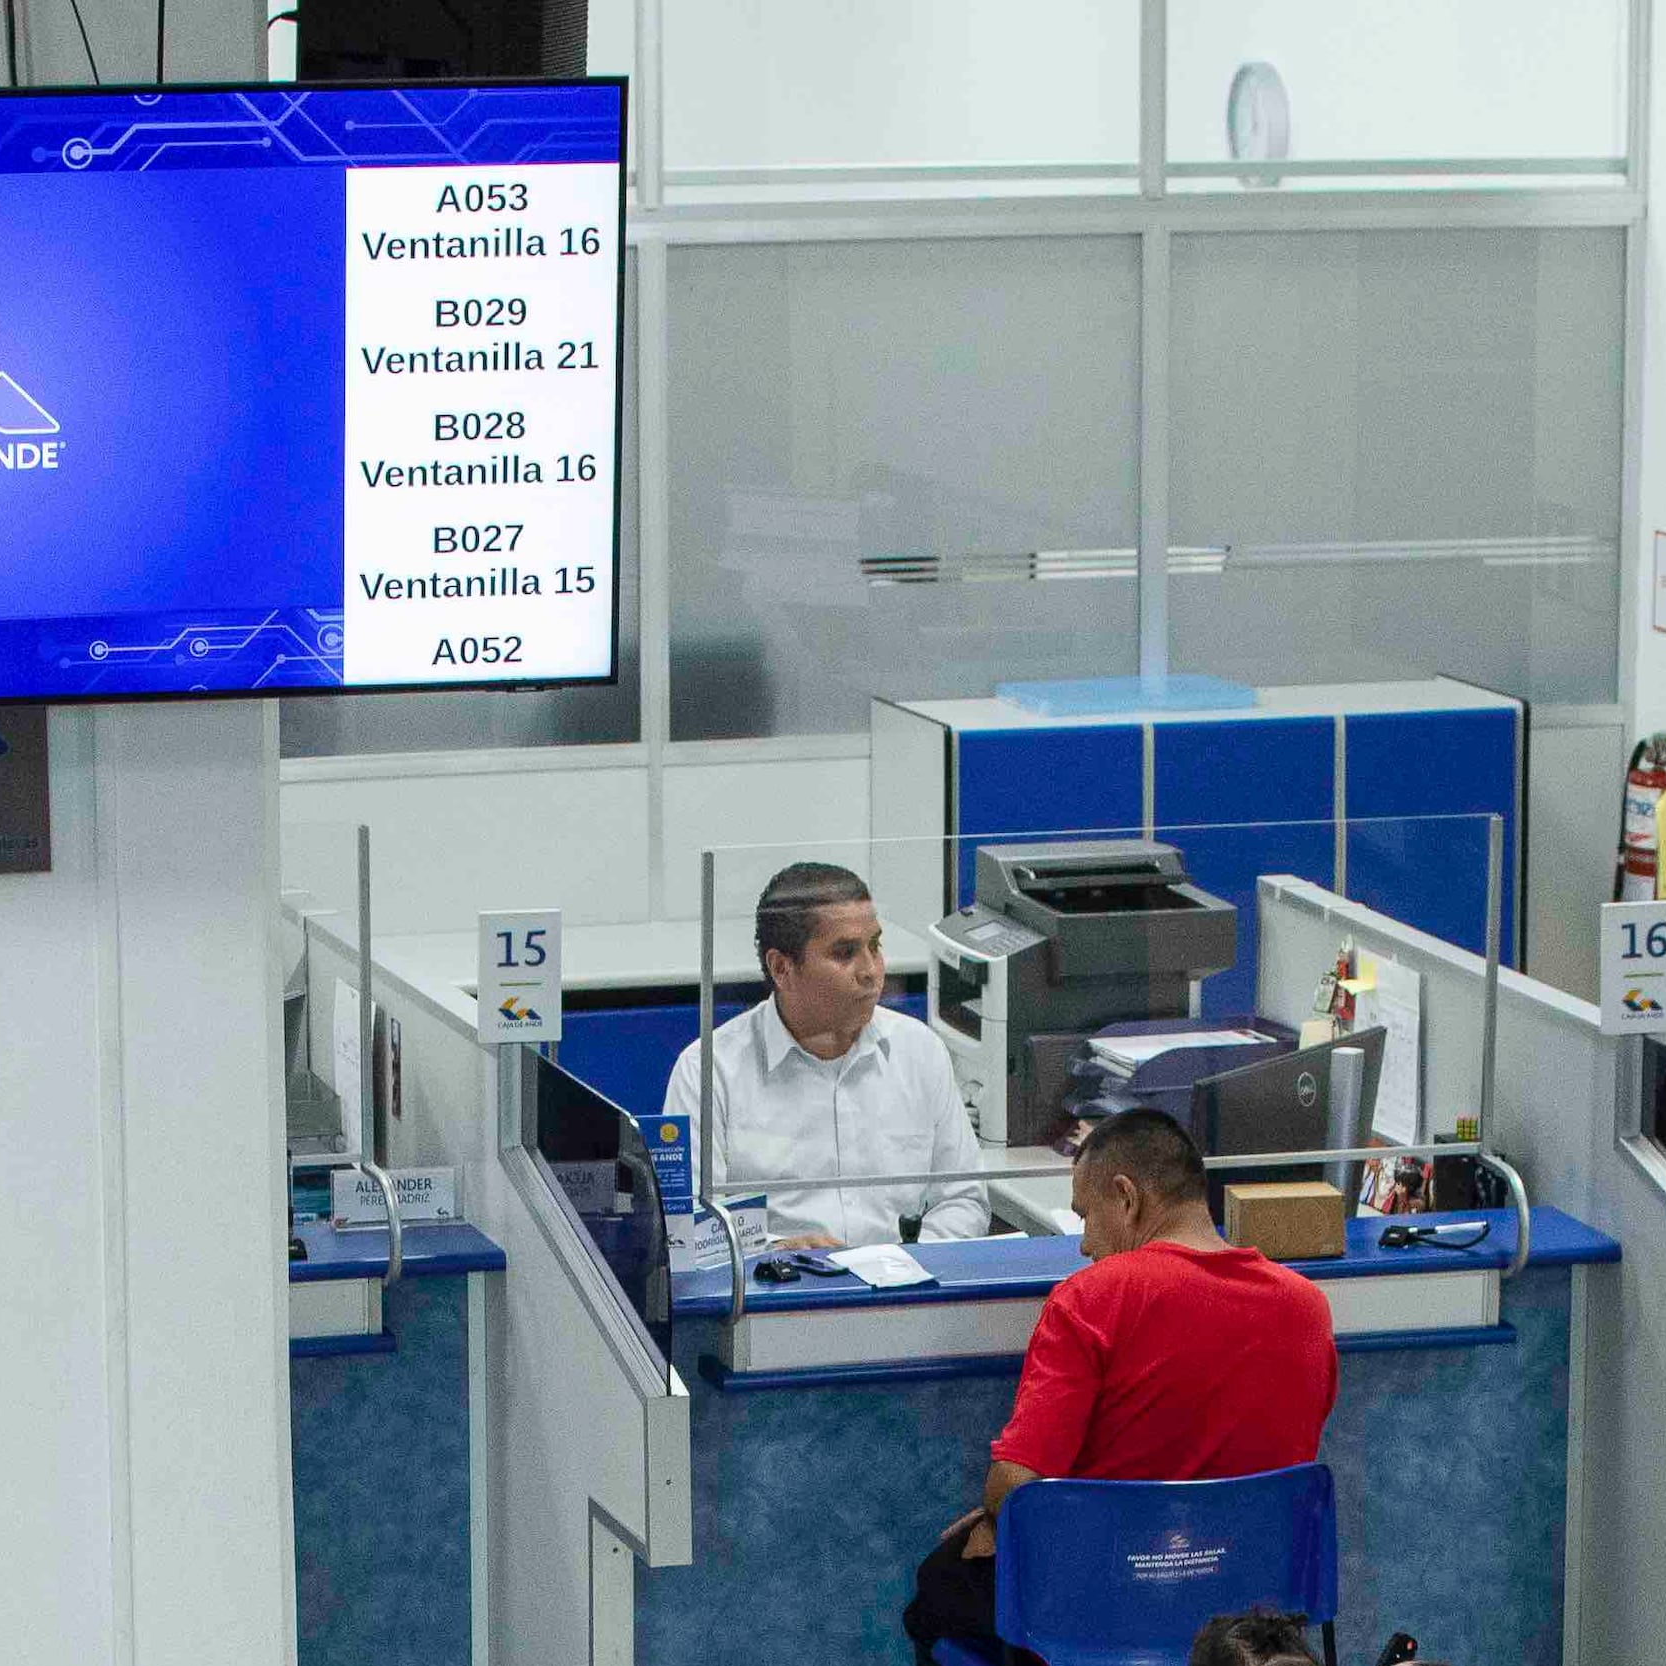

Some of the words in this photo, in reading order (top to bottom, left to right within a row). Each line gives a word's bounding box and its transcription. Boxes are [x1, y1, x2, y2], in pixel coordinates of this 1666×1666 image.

[436, 183, 528, 213] A053
[362, 227, 547, 260] Ventanilla
[560, 227, 600, 256] 16
[436, 298, 527, 328] B029
[361, 341, 545, 374] Ventanilla
[557, 341, 599, 369] 21
[435, 411, 525, 441] B028
[360, 455, 543, 488] Ventanilla
[556, 454, 596, 482] 16
[434, 524, 524, 554] B027
[359, 567, 542, 600] Ventanilla
[555, 566, 595, 594] 15
[431, 636, 522, 665] A052
[496, 930, 546, 967] 15
